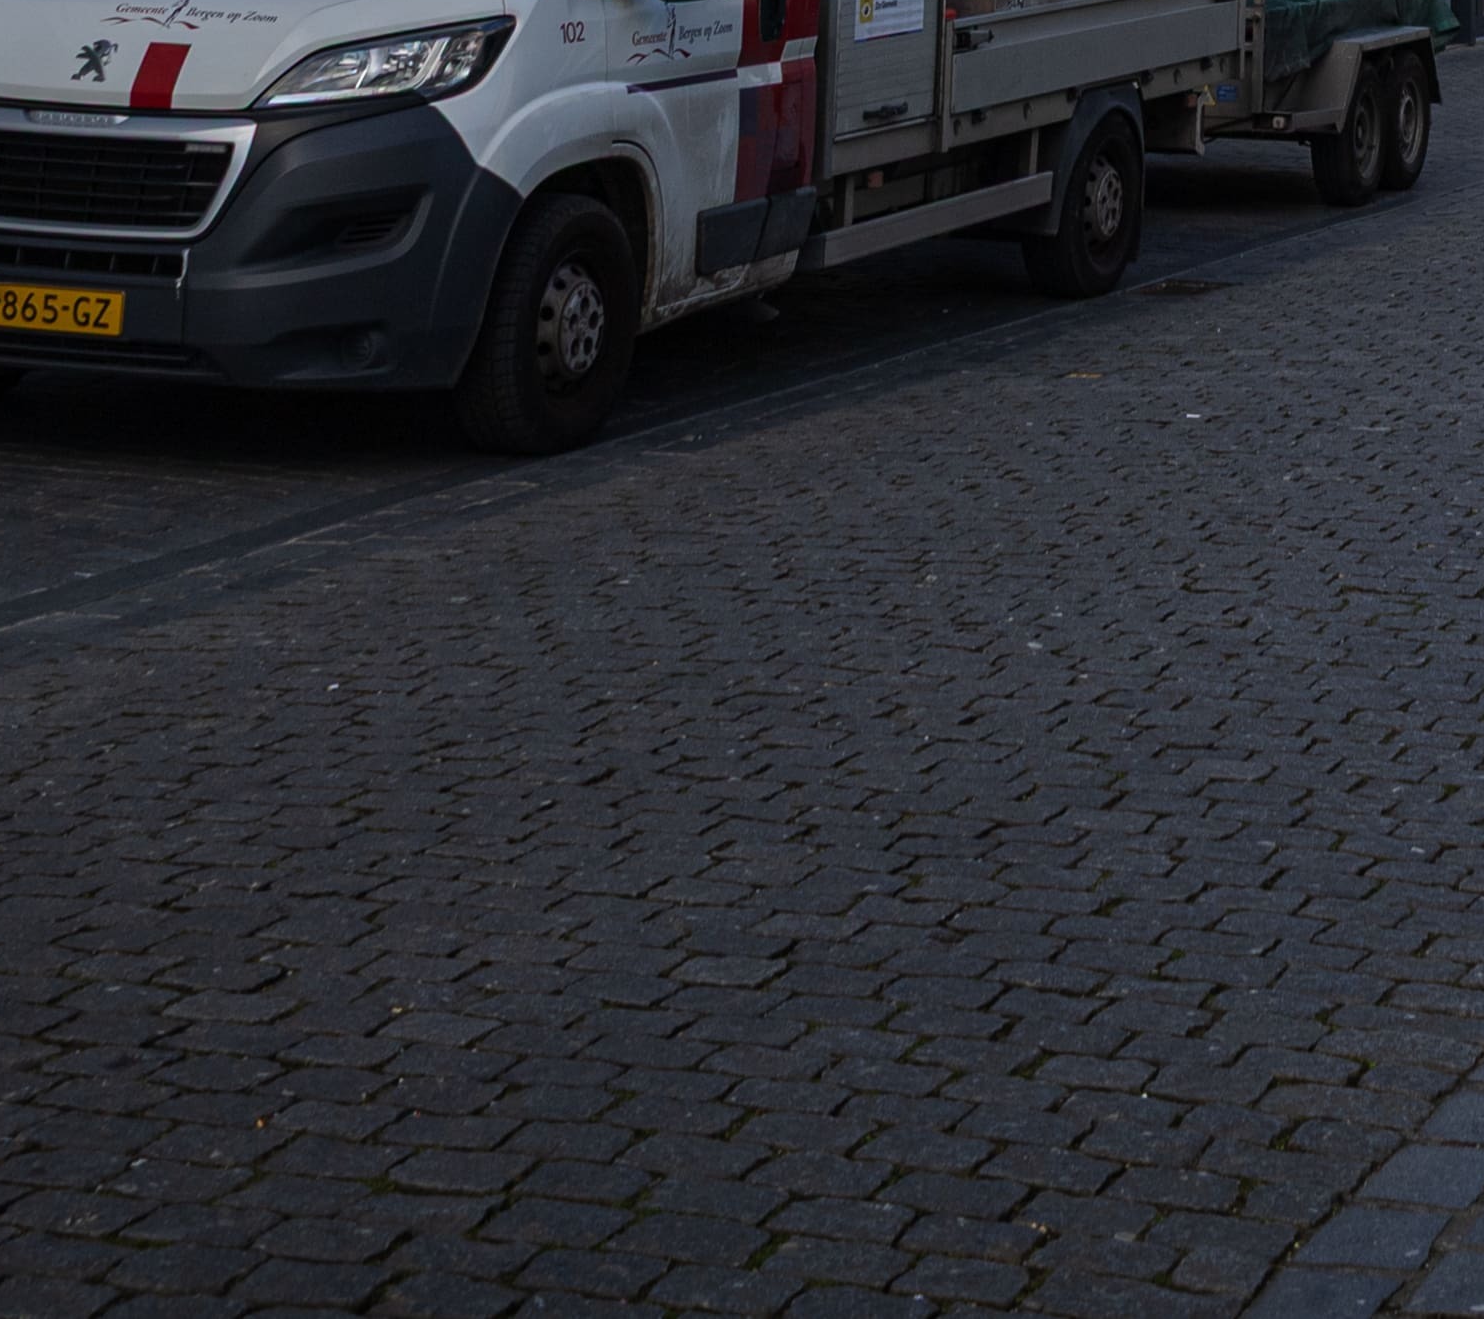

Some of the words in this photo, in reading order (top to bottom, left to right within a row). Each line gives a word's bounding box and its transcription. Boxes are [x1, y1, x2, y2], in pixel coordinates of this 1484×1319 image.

[116, 3, 168, 15] Gemeente
[186, 7, 225, 21] Bergen
[227, 12, 242, 24] op
[243, 11, 278, 23] Zoom
[559, 21, 585, 44] 102
[632, 30, 667, 46] Gemeente
[678, 25, 703, 44] Bergen
[713, 20, 733, 35] Zoom
